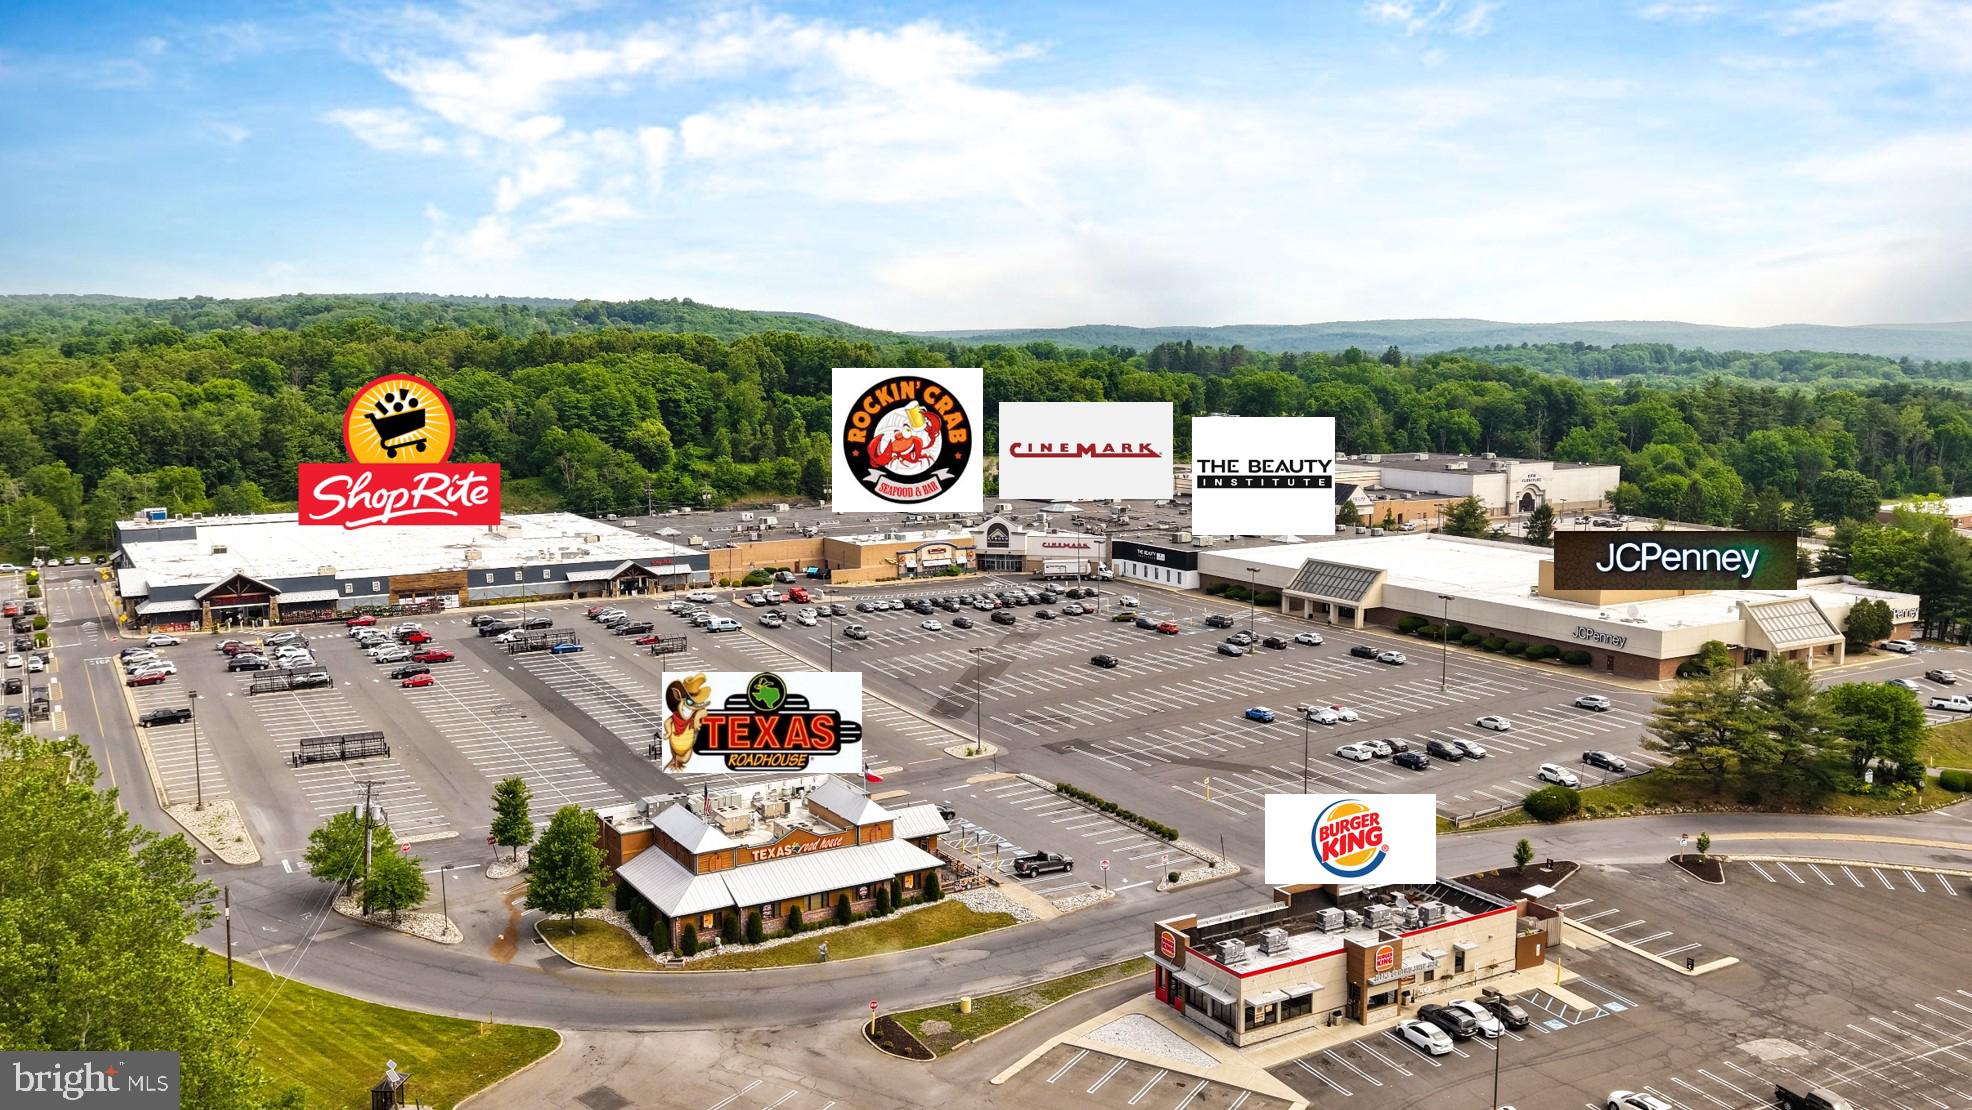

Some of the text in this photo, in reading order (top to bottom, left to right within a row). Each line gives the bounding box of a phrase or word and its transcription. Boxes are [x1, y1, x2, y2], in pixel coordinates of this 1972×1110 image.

[1572, 626, 1628, 649] JCPenney
[752, 837, 843, 861] TEXAS road house
